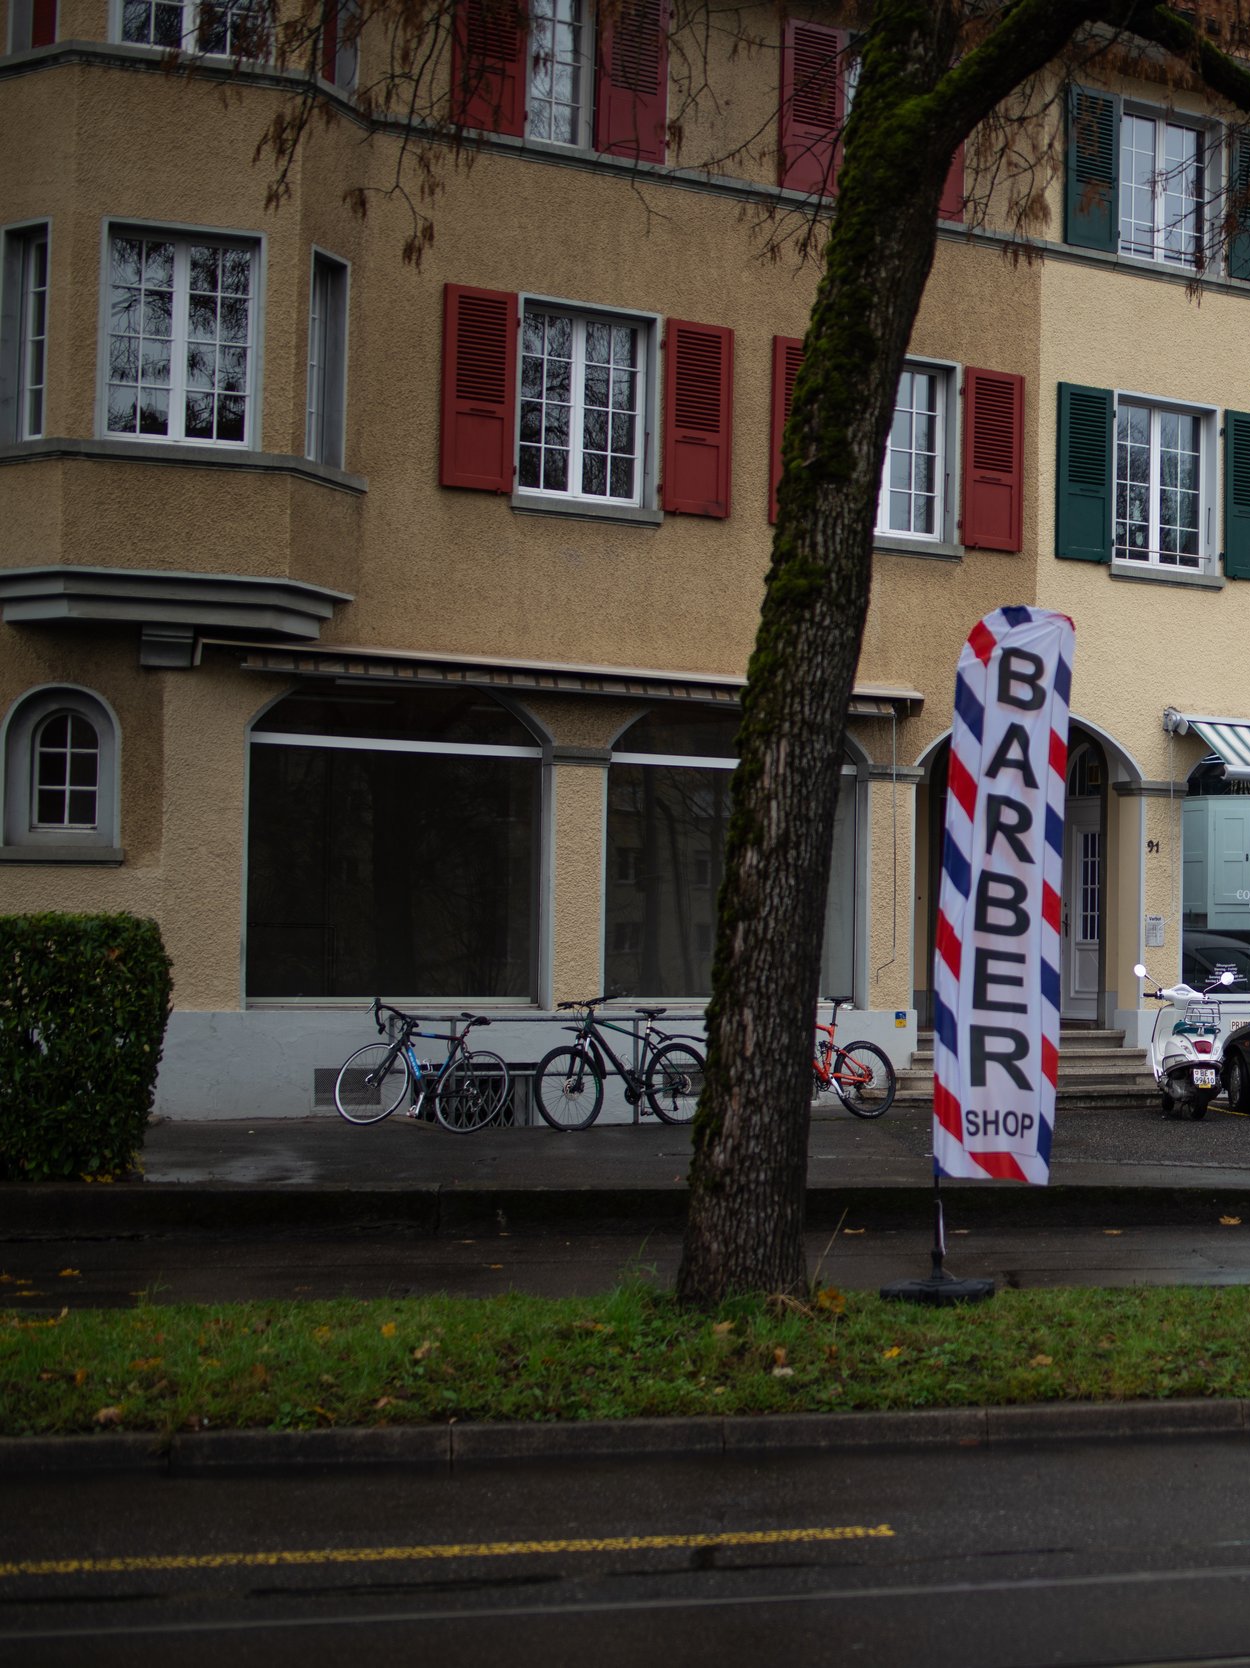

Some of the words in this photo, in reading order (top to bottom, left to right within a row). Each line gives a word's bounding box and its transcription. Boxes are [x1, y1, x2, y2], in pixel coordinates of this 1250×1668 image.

[1147, 839, 1160, 854] 91
[968, 646, 1046, 1092] BARBER
[965, 1108, 1034, 1139] SHOP
